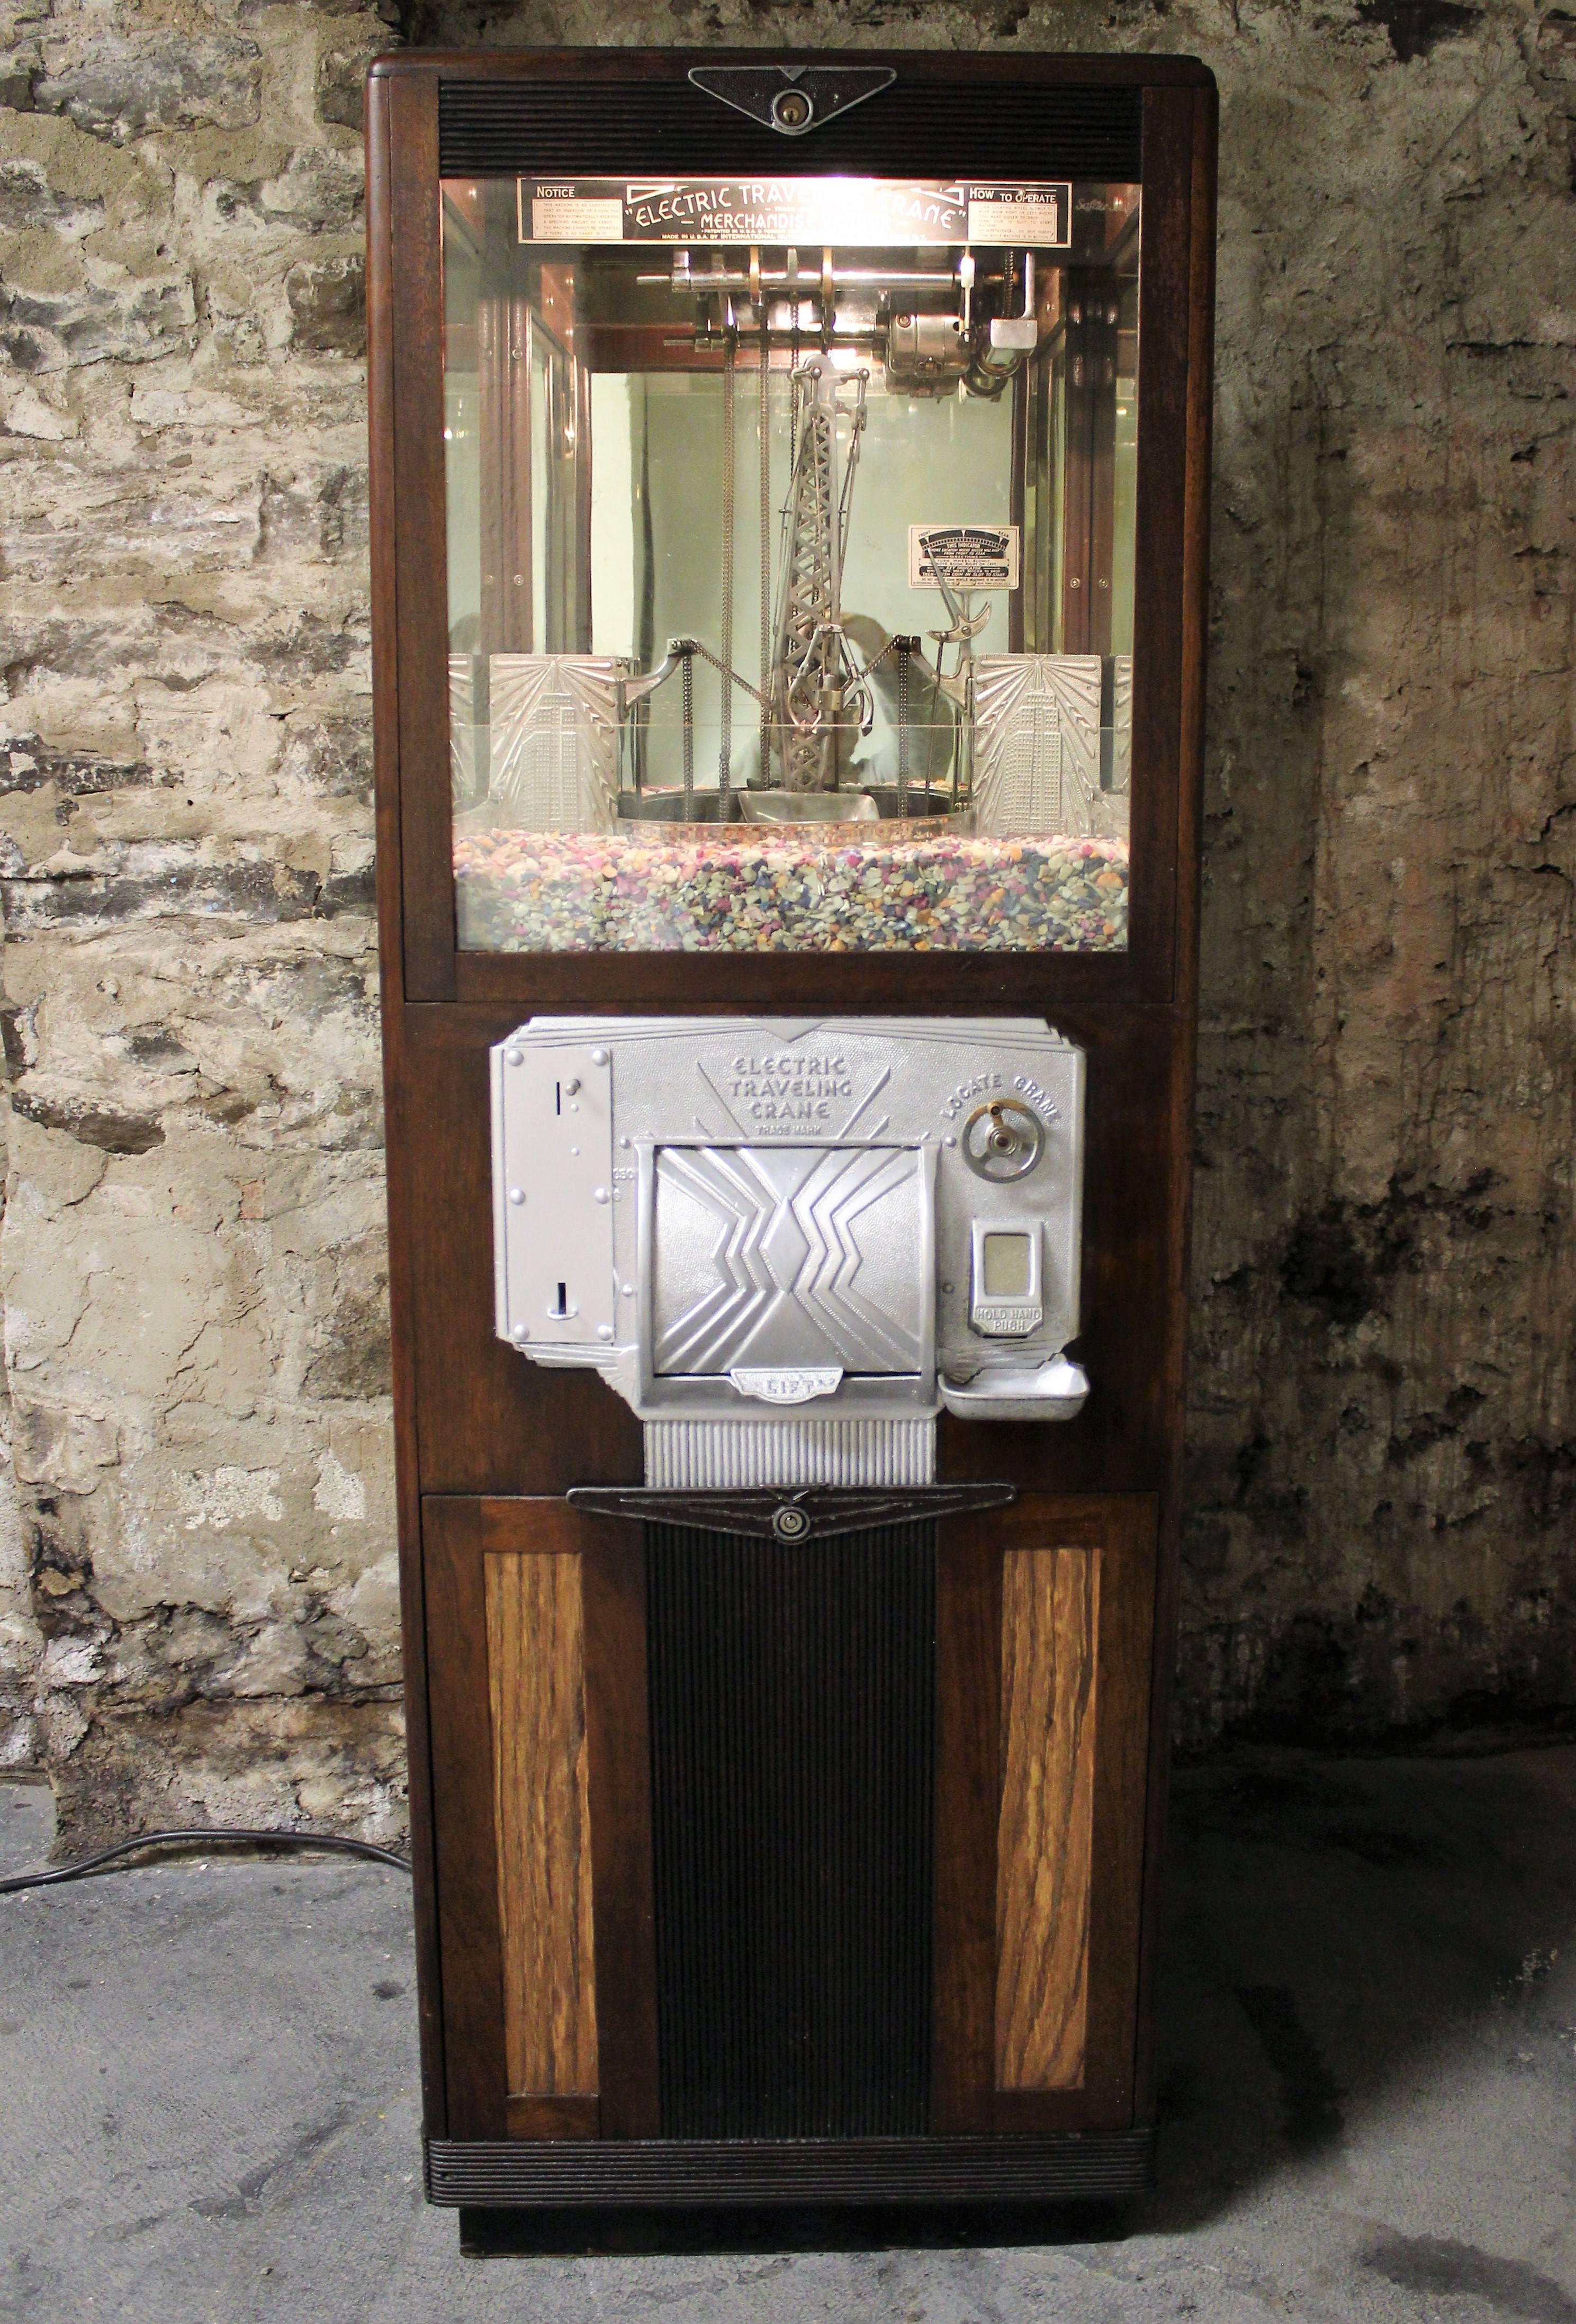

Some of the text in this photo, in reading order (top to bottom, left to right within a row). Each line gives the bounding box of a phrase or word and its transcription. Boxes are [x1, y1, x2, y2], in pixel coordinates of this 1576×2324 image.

[537, 186, 575, 198] NOTICE
[969, 187, 1056, 203] HOW TO OPERATE
[732, 1057, 846, 1075] ELECTRIC
[728, 1079, 852, 1097] TRAVELING
[940, 1073, 1060, 1121] LOCATE CRANE
[750, 1101, 830, 1120] CRANE
[755, 1125, 822, 1136] TRADE MARK
[977, 1308, 1042, 1320] HOLD HAND
[766, 1380, 814, 1394] LIFT
